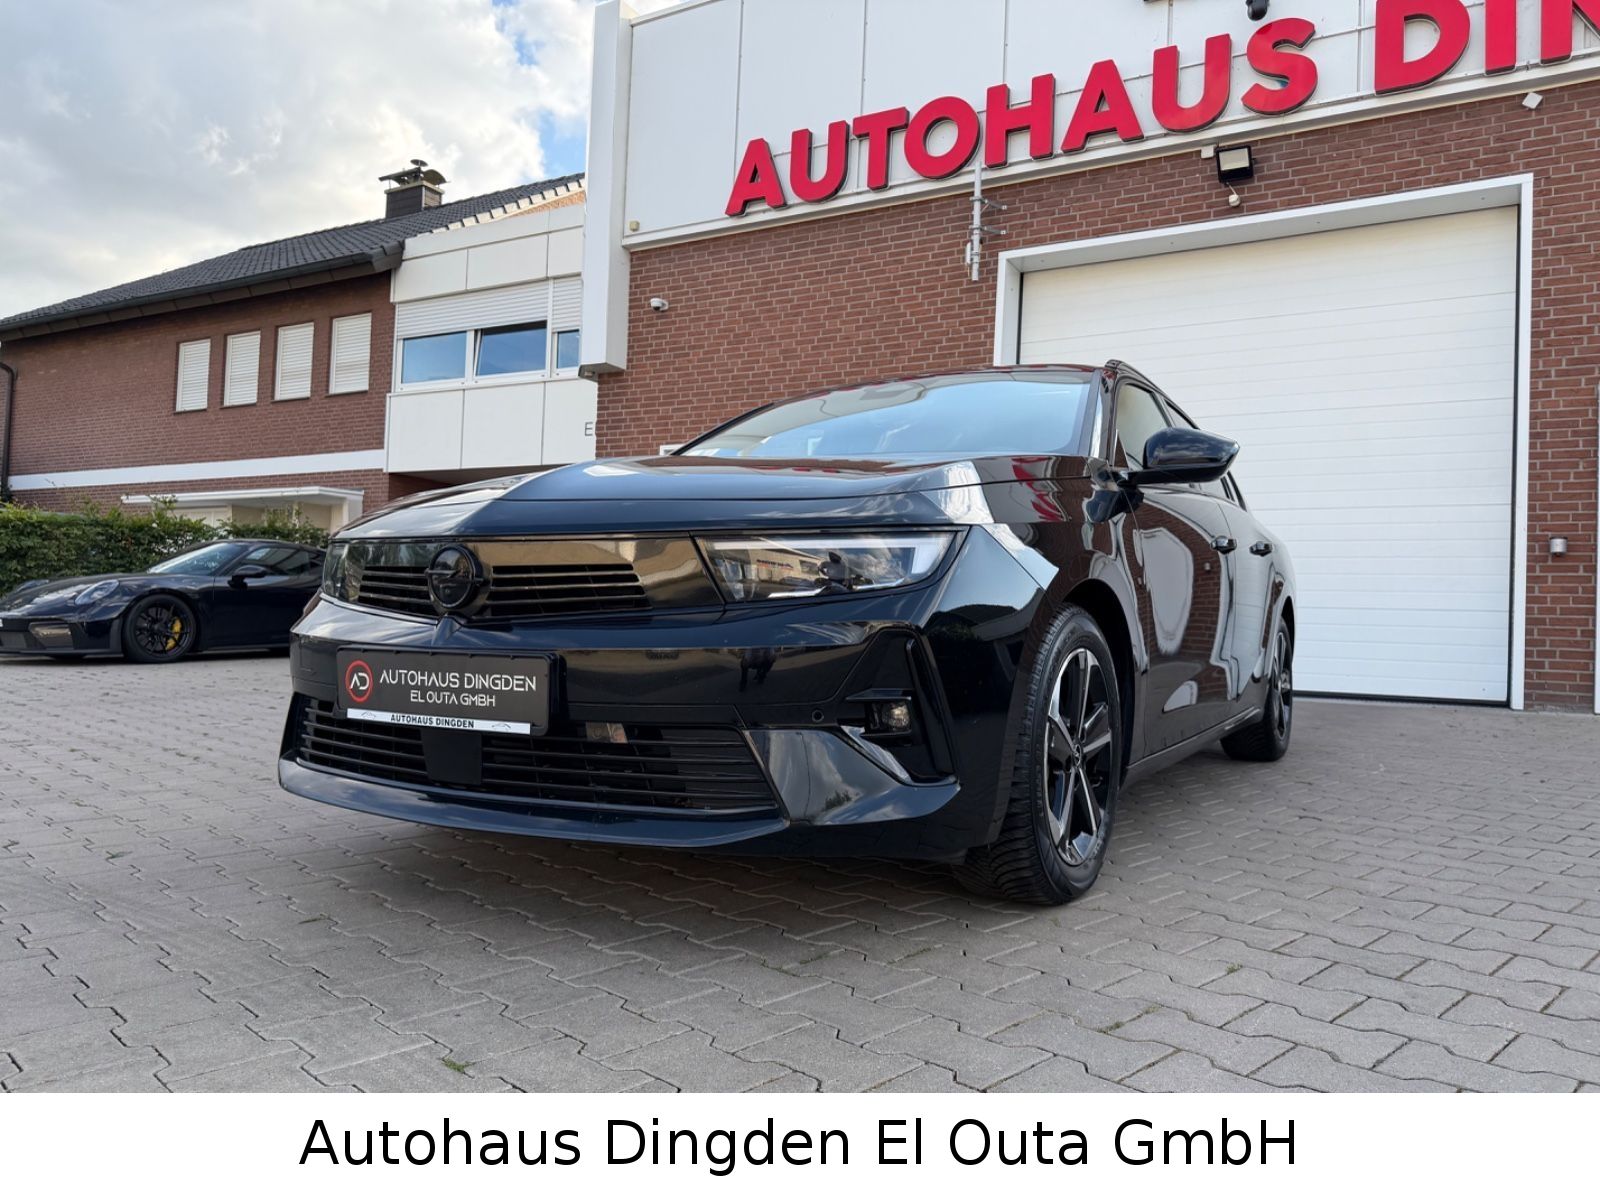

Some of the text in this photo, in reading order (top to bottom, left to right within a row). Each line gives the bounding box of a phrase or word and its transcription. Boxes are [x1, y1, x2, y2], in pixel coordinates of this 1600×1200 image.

[725, 18, 1318, 217] AUTOHAUS
[379, 668, 536, 691] AUTOHAUS DINGDEN
[410, 689, 496, 707] EL OUTA GMBH
[390, 714, 475, 729] AUTOHAUS DINGDEN
